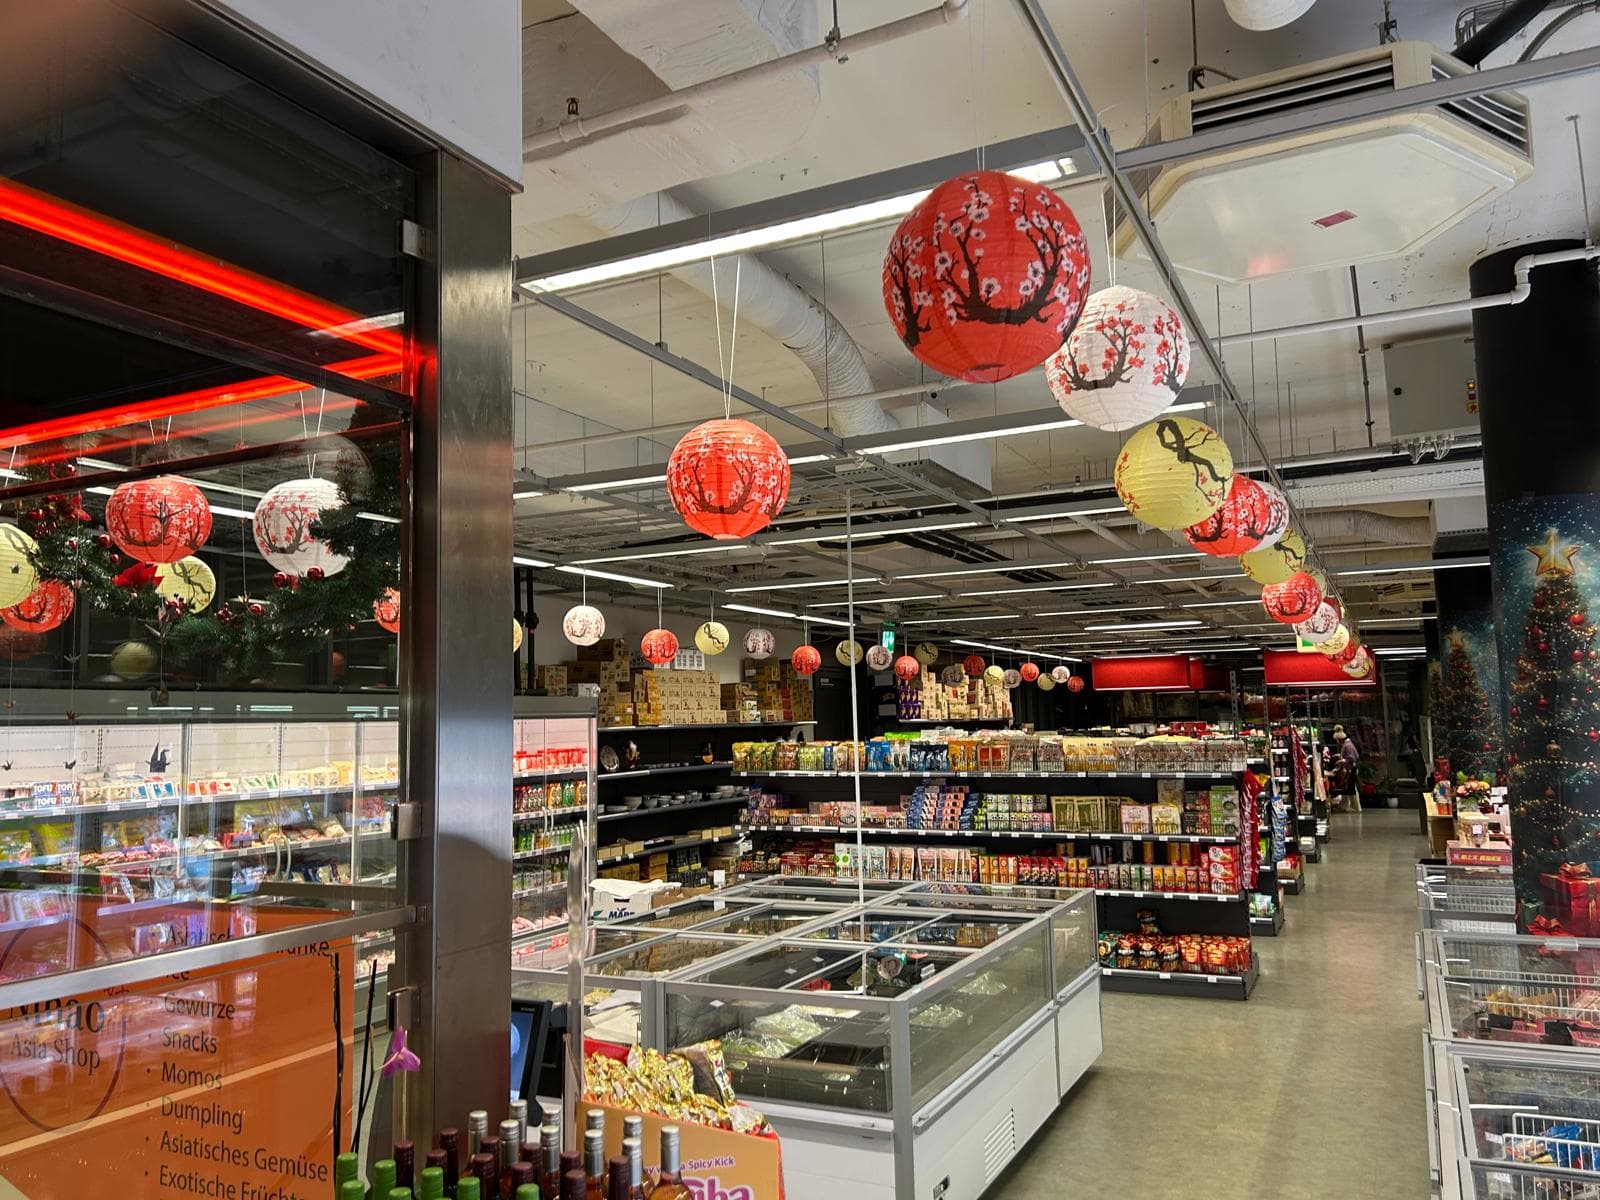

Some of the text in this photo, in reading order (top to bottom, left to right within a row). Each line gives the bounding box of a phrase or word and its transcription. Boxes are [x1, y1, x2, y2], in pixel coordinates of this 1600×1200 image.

[164, 992, 236, 1020] Gewürze
[11, 1033, 101, 1076] Asia Shop
[162, 1027, 218, 1055] Snacks
[161, 1060, 223, 1090] Momos
[161, 1096, 243, 1135] Dumpling
[160, 1130, 328, 1182] Asiatisches Gemüse
[688, 1159, 713, 1171] Spicy
[714, 1157, 734, 1167] Kick
[159, 1164, 237, 1200] Exotische
